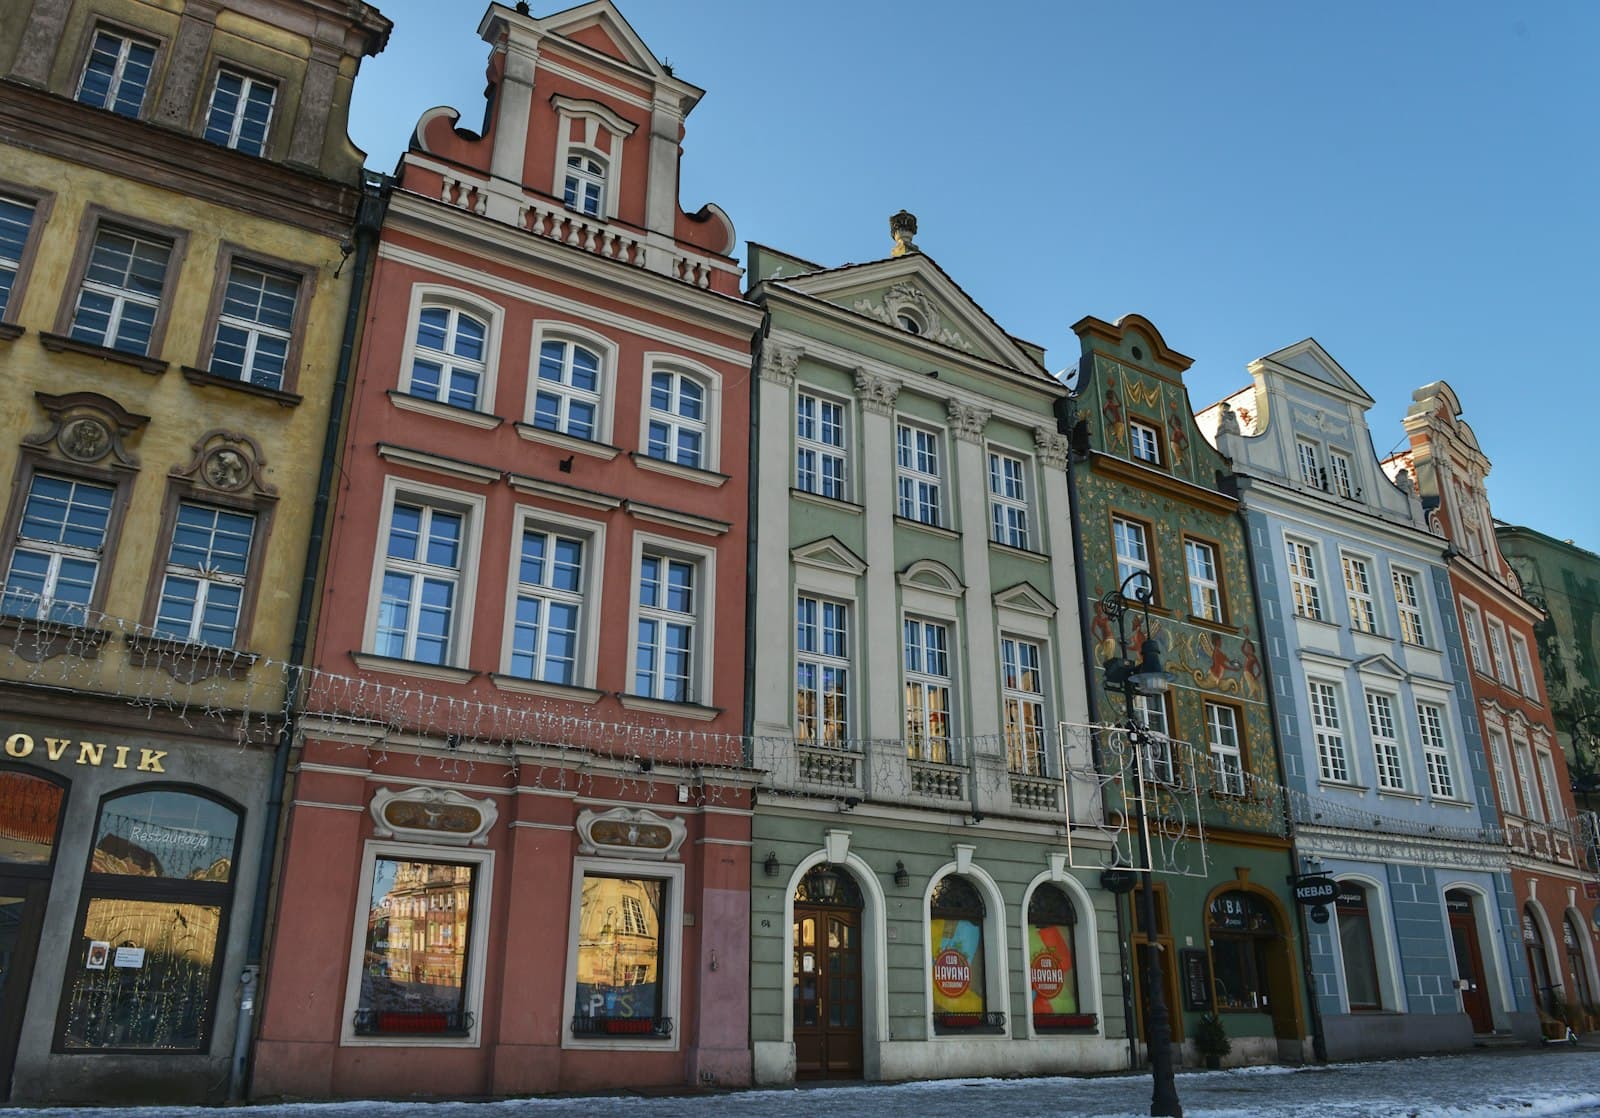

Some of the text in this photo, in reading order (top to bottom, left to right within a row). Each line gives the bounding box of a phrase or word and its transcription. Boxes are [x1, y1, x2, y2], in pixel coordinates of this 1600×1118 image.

[5, 733, 168, 773] OVNIK
[129, 826, 209, 848] Restauracja
[1296, 885, 1334, 898] KEBAB
[934, 966, 970, 981] HAVANA
[1031, 968, 1064, 983] HAVANA
